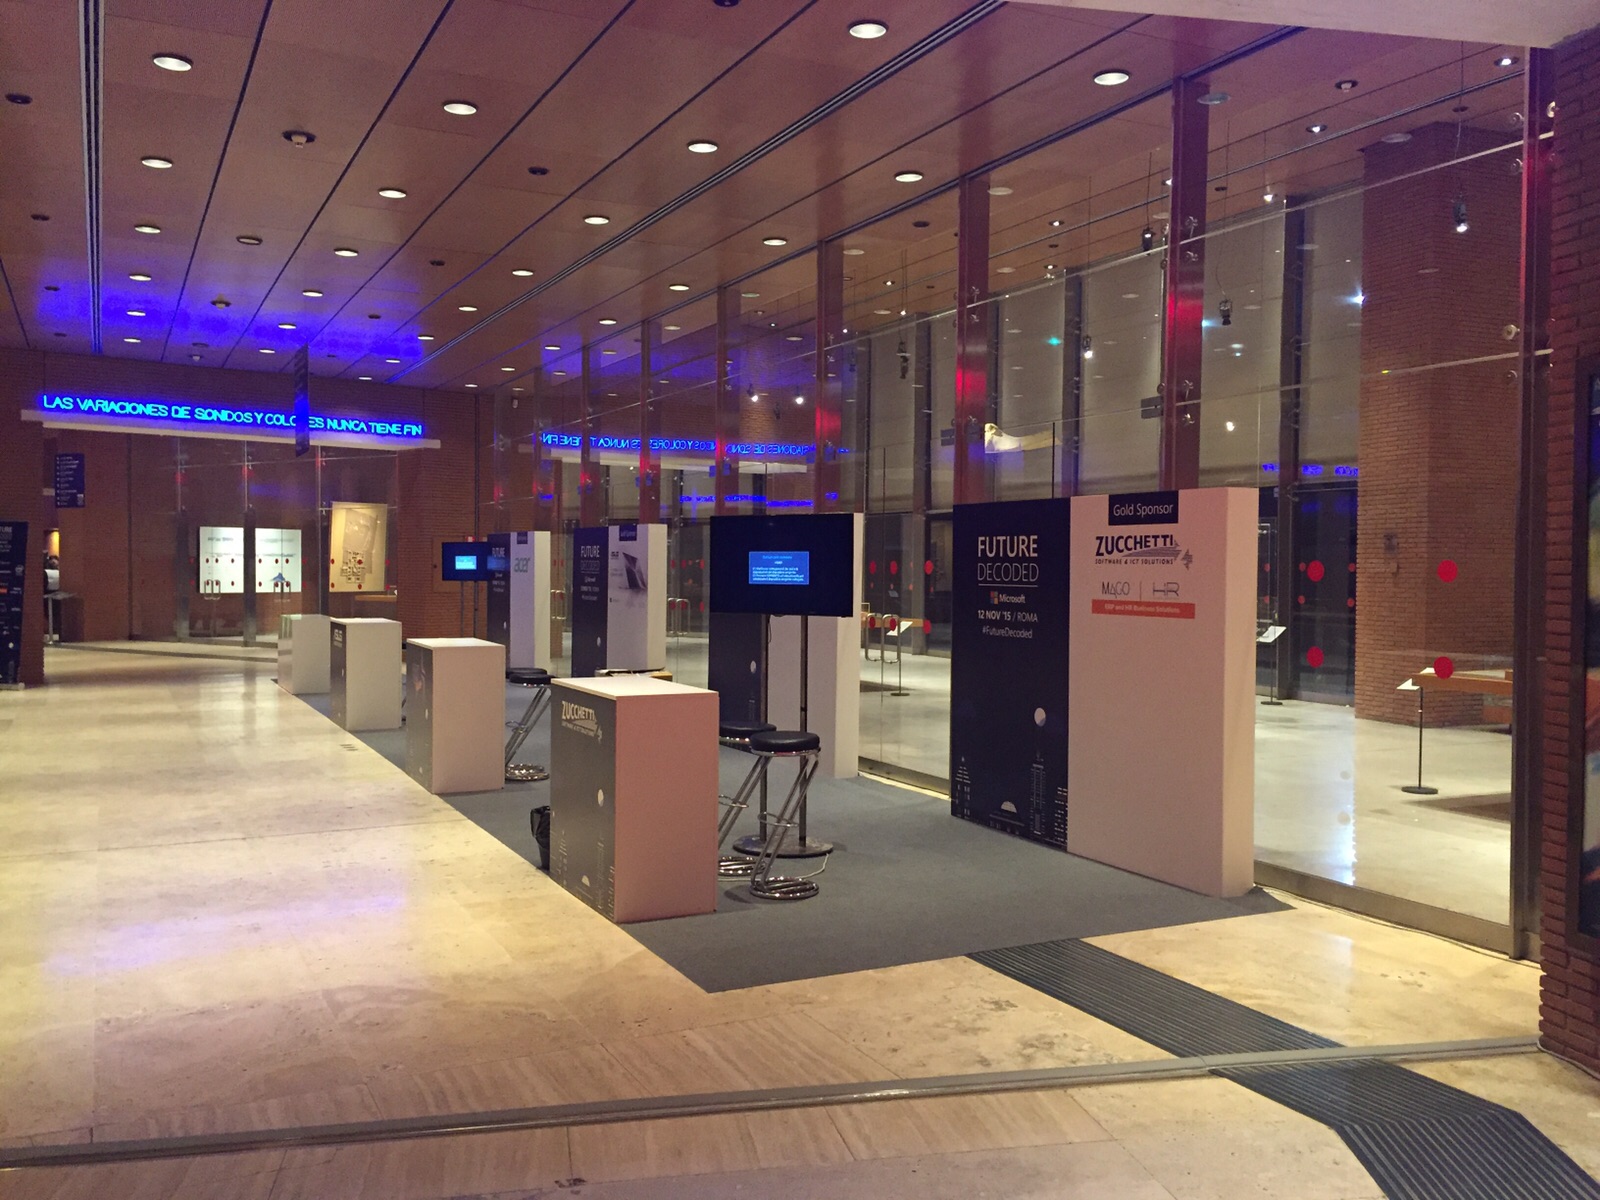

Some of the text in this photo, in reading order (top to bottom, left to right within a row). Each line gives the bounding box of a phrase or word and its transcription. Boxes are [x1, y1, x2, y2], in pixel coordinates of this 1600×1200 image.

[43, 394, 74, 410] LAS
[76, 397, 168, 417] VARIACIONES
[171, 405, 191, 419] DE
[254, 411, 264, 425] Y
[265, 413, 325, 428] COLOES
[326, 417, 367, 433] NUNCA
[1113, 503, 1174, 518] Gold Sponsor
[978, 535, 1038, 557] FUTURE
[1095, 534, 1174, 557] ZUCCHETTI
[977, 563, 1040, 582] DECODED
[999, 594, 1026, 603] Microsoft
[978, 610, 985, 620] 12
[986, 610, 1001, 620] NOV
[1002, 611, 1012, 621] '15
[1017, 612, 1038, 622] ROMA
[982, 625, 1033, 639] #FutureDecoded
[561, 700, 595, 720] ZUCCHETTI
